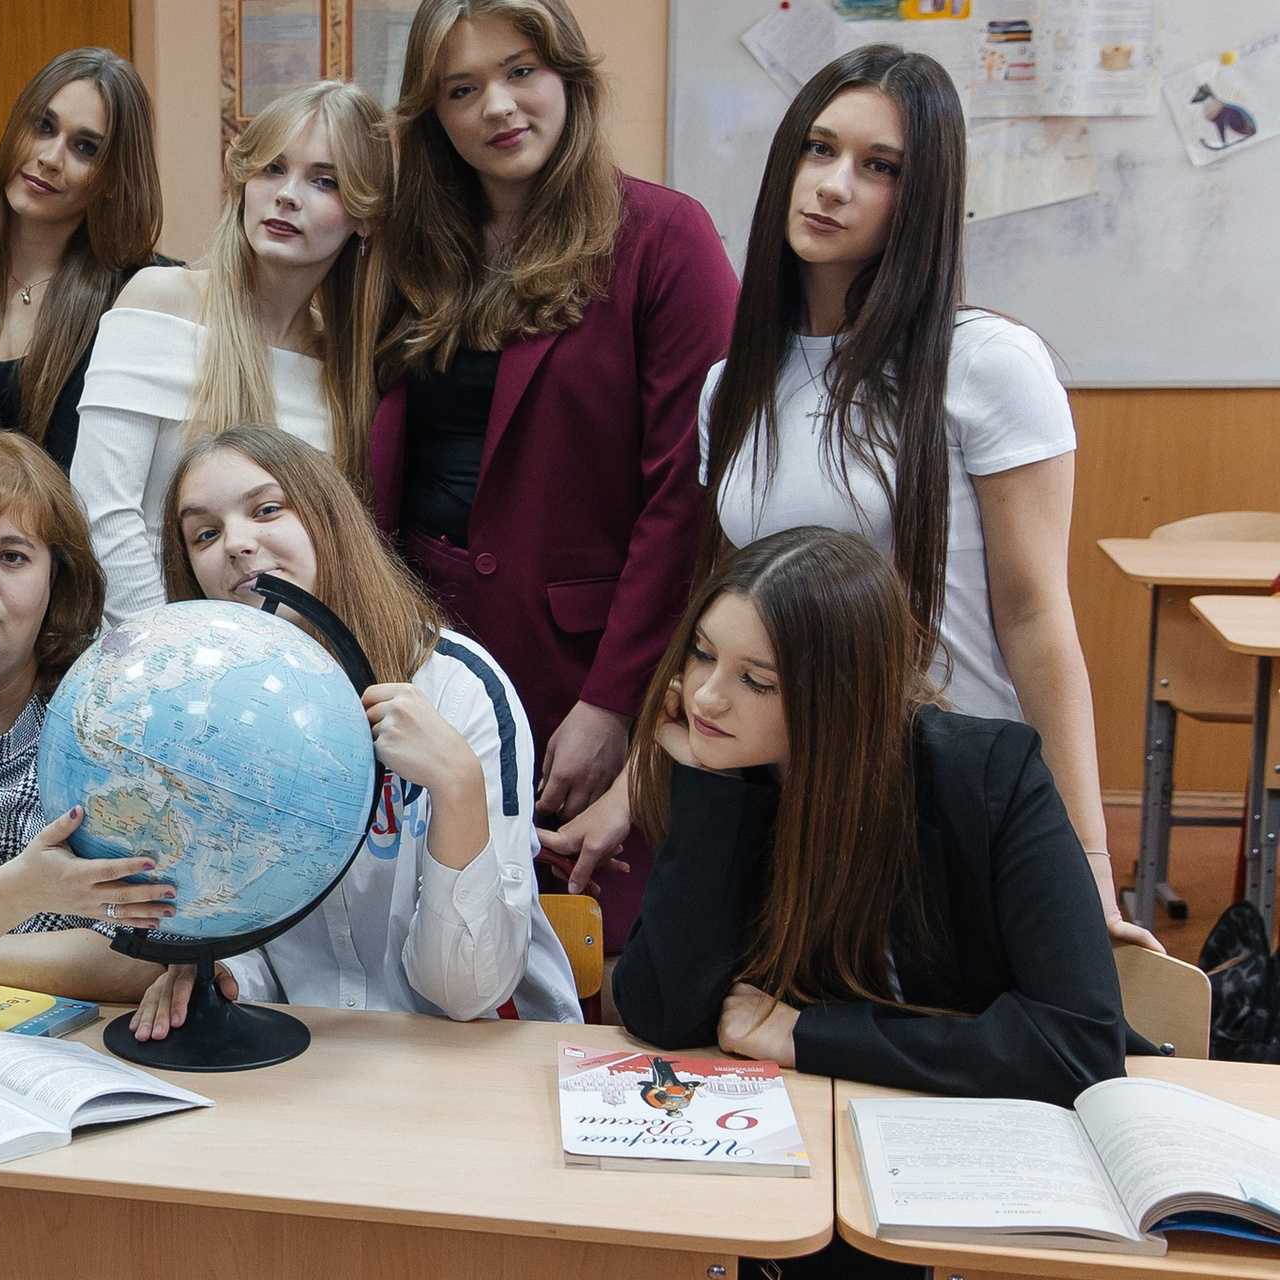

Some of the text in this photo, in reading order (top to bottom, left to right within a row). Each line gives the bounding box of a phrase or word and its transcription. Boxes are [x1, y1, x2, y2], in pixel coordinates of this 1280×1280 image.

[575, 1116, 693, 1136] России
[716, 1107, 763, 1131] 9
[577, 1131, 755, 1158] История
